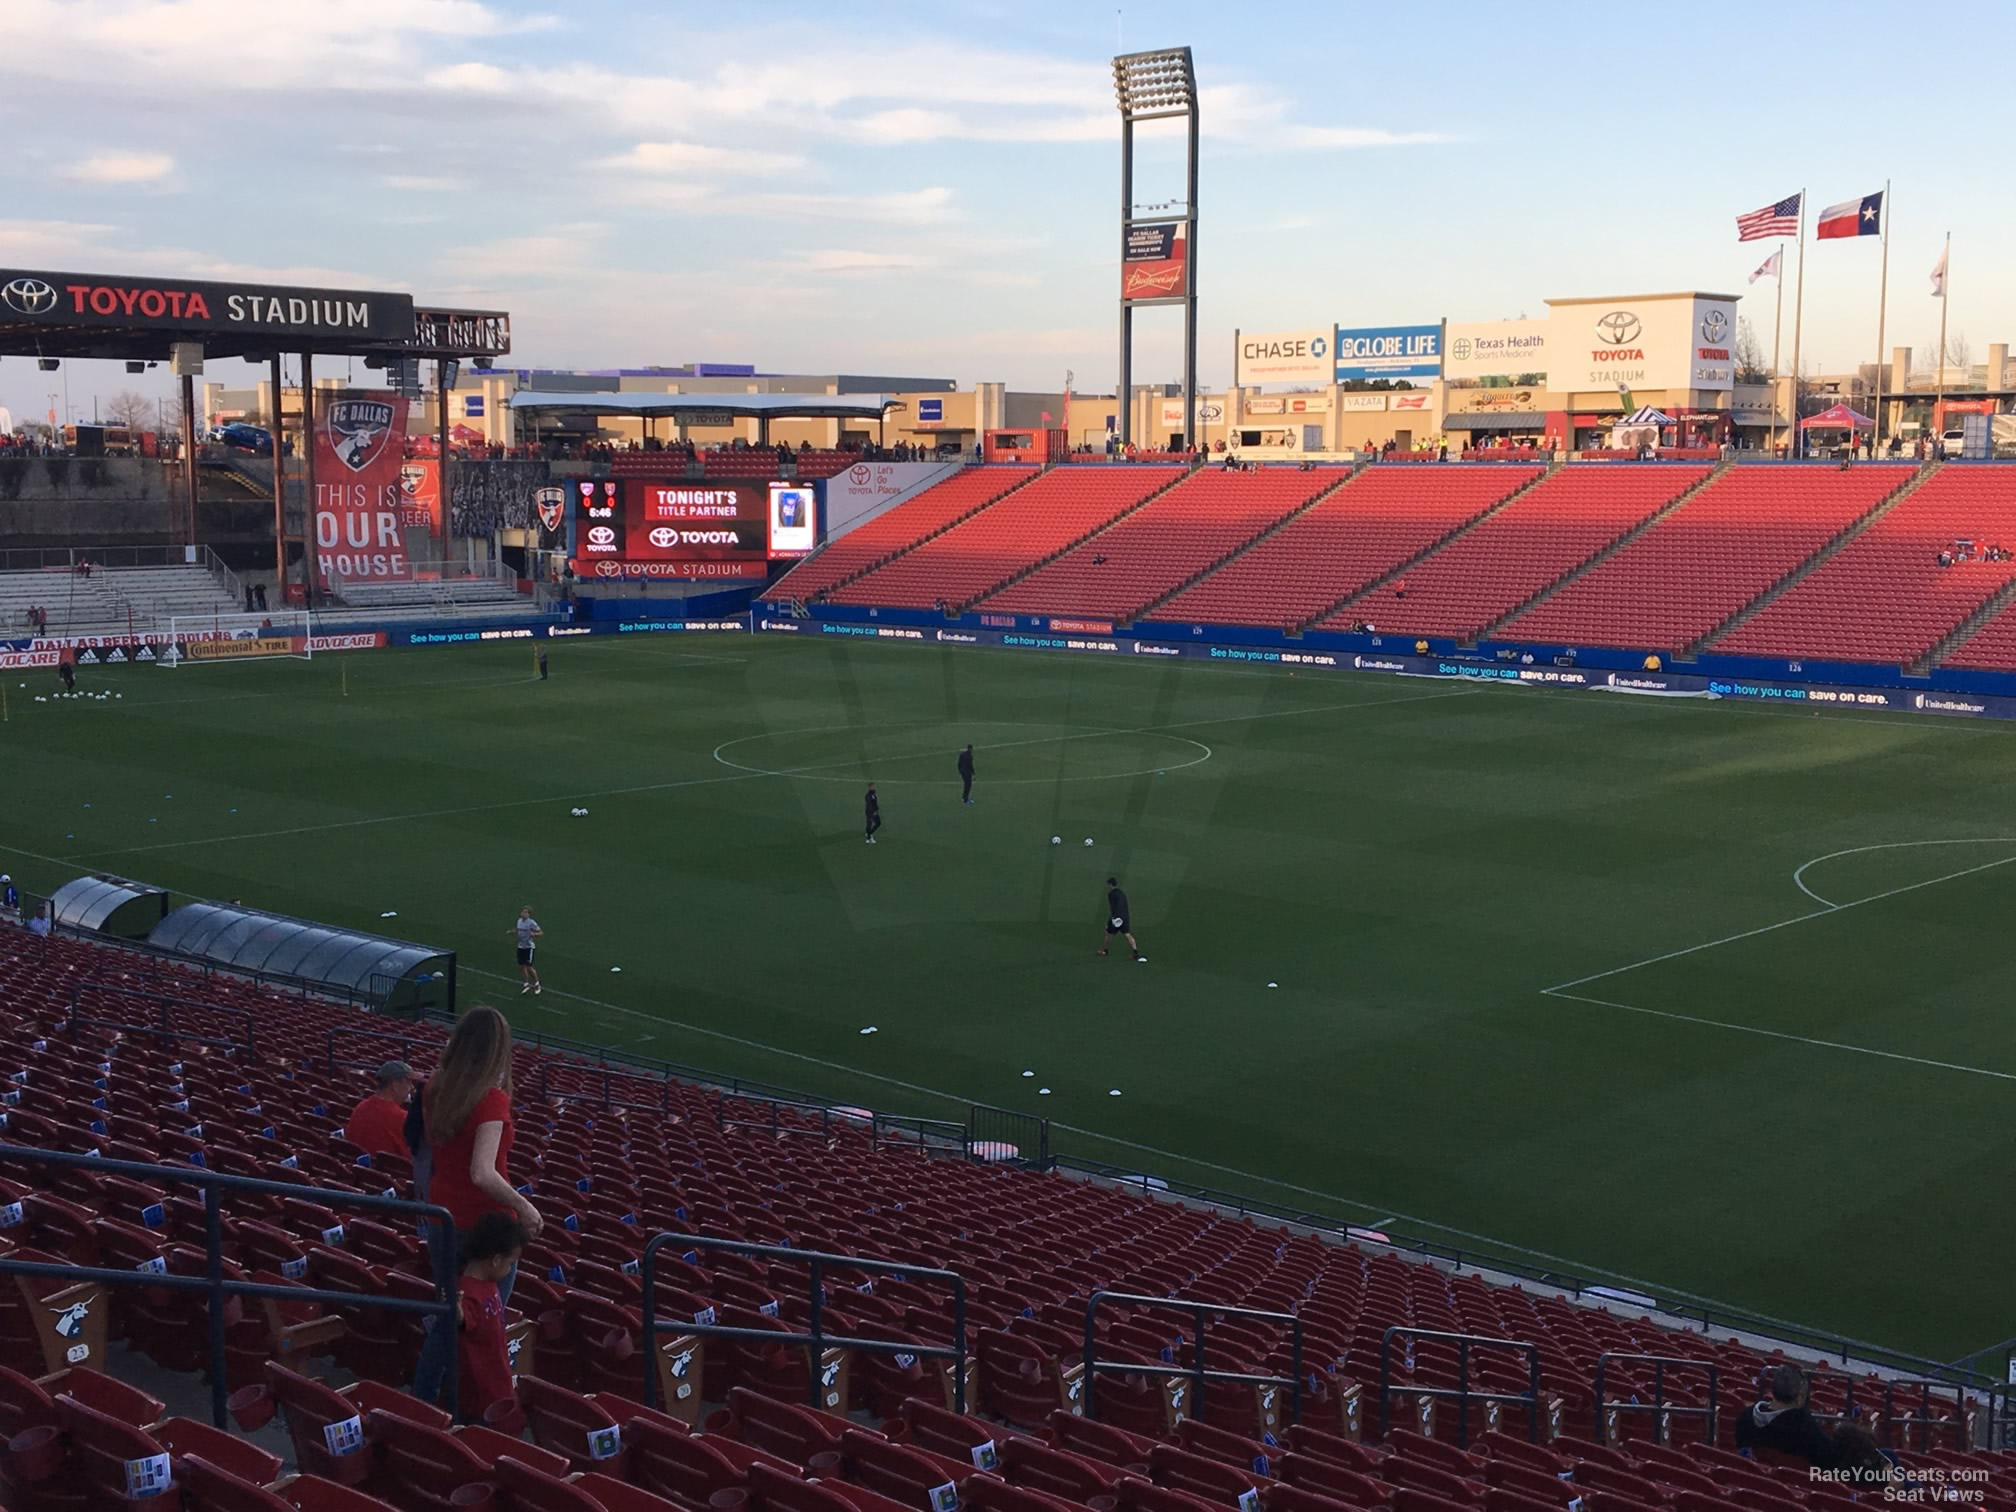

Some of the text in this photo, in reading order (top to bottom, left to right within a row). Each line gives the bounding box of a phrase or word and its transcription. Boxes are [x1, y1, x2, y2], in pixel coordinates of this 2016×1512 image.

[66, 285, 369, 328] TOYOTA STADIUM
[1354, 335, 1436, 357] GLOBE LIFE
[1474, 335, 1544, 350] Texas Health
[1244, 340, 1306, 360] CHASE
[1474, 349, 1534, 362] Sports Medicine
[1592, 350, 1644, 362] TOYOTA
[1590, 370, 1645, 382] STADIUM
[1348, 396, 1383, 407] VAZATA
[333, 403, 389, 423] FC DALLAS
[694, 414, 733, 424] TOYOTA
[877, 466, 894, 474] Let's
[877, 476, 888, 484] Go
[316, 484, 396, 507] THIS IS
[877, 486, 901, 494] Places
[657, 490, 737, 505] TONIGHT'S
[658, 506, 737, 516] TITLE PARTNER
[316, 511, 400, 548] OUR
[680, 531, 739, 544] TOYOTA
[587, 544, 617, 552] TOYOTA
[318, 554, 404, 577] HOUSE
[624, 564, 742, 576] TOYOTA STADIUM
[619, 623, 633, 632] See
[634, 622, 650, 630] how
[650, 622, 666, 631] you
[823, 624, 836, 632] See
[837, 625, 850, 634] how
[852, 627, 864, 636] you
[864, 627, 877, 635] can
[878, 628, 894, 636] save
[906, 630, 923, 638] care.
[1085, 624, 1113, 632] STADIUM
[34, 630, 232, 651] DALLAS BEER GUARDIANS
[304, 634, 375, 650] ADVOCARE
[410, 634, 427, 644] See
[428, 633, 446, 642] how
[447, 634, 463, 643] you
[481, 631, 500, 640] save
[513, 630, 534, 638] care.
[1004, 635, 1018, 644] See
[1020, 636, 1036, 645] how
[1036, 638, 1050, 648] you
[1052, 639, 1066, 647] can
[1068, 640, 1086, 649] save
[1098, 642, 1118, 651] care.
[190, 642, 289, 658] Continental TIRE
[1210, 648, 1336, 665] See how you can save on care.
[1439, 663, 1586, 683] See how you can save on care.
[1616, 678, 1668, 689] UnitedHealthcare
[1710, 682, 1889, 705] See how you can save on care.
[1924, 700, 1985, 713] UnitedHealthcare
[70, 1347, 85, 1360] 23
